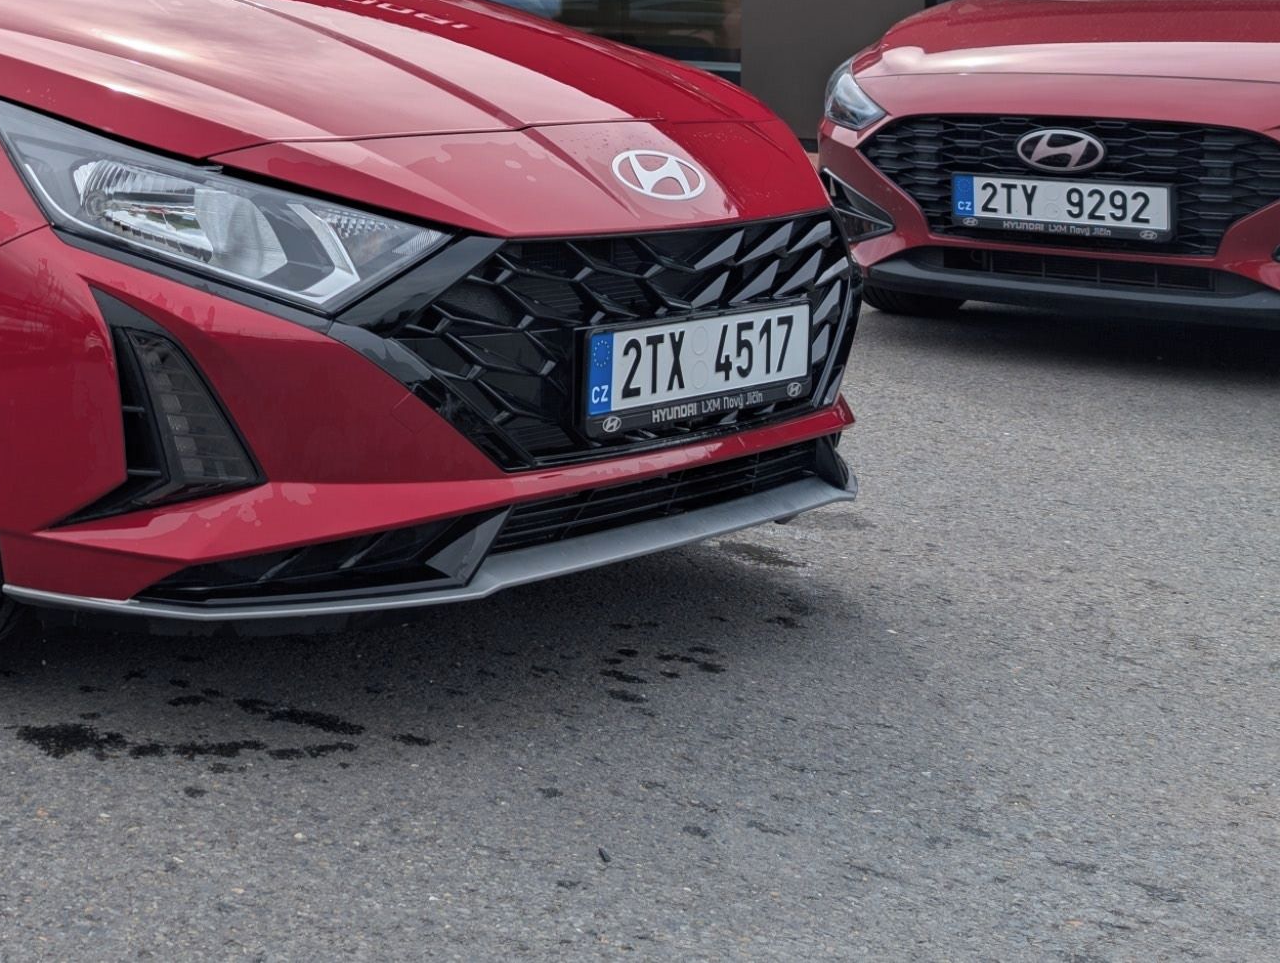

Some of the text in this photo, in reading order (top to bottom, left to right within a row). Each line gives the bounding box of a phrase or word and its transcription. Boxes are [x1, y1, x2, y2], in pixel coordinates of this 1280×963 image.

[957, 201, 972, 211] CZ
[981, 182, 1151, 224] 2TY 9292
[1003, 220, 1045, 232] HYUNDAI
[1049, 224, 1066, 233] LXM
[622, 315, 795, 400] 2TX 4517
[591, 384, 609, 404] CZ
[651, 402, 698, 423] HYUNDAI
[701, 397, 721, 414] LXM
